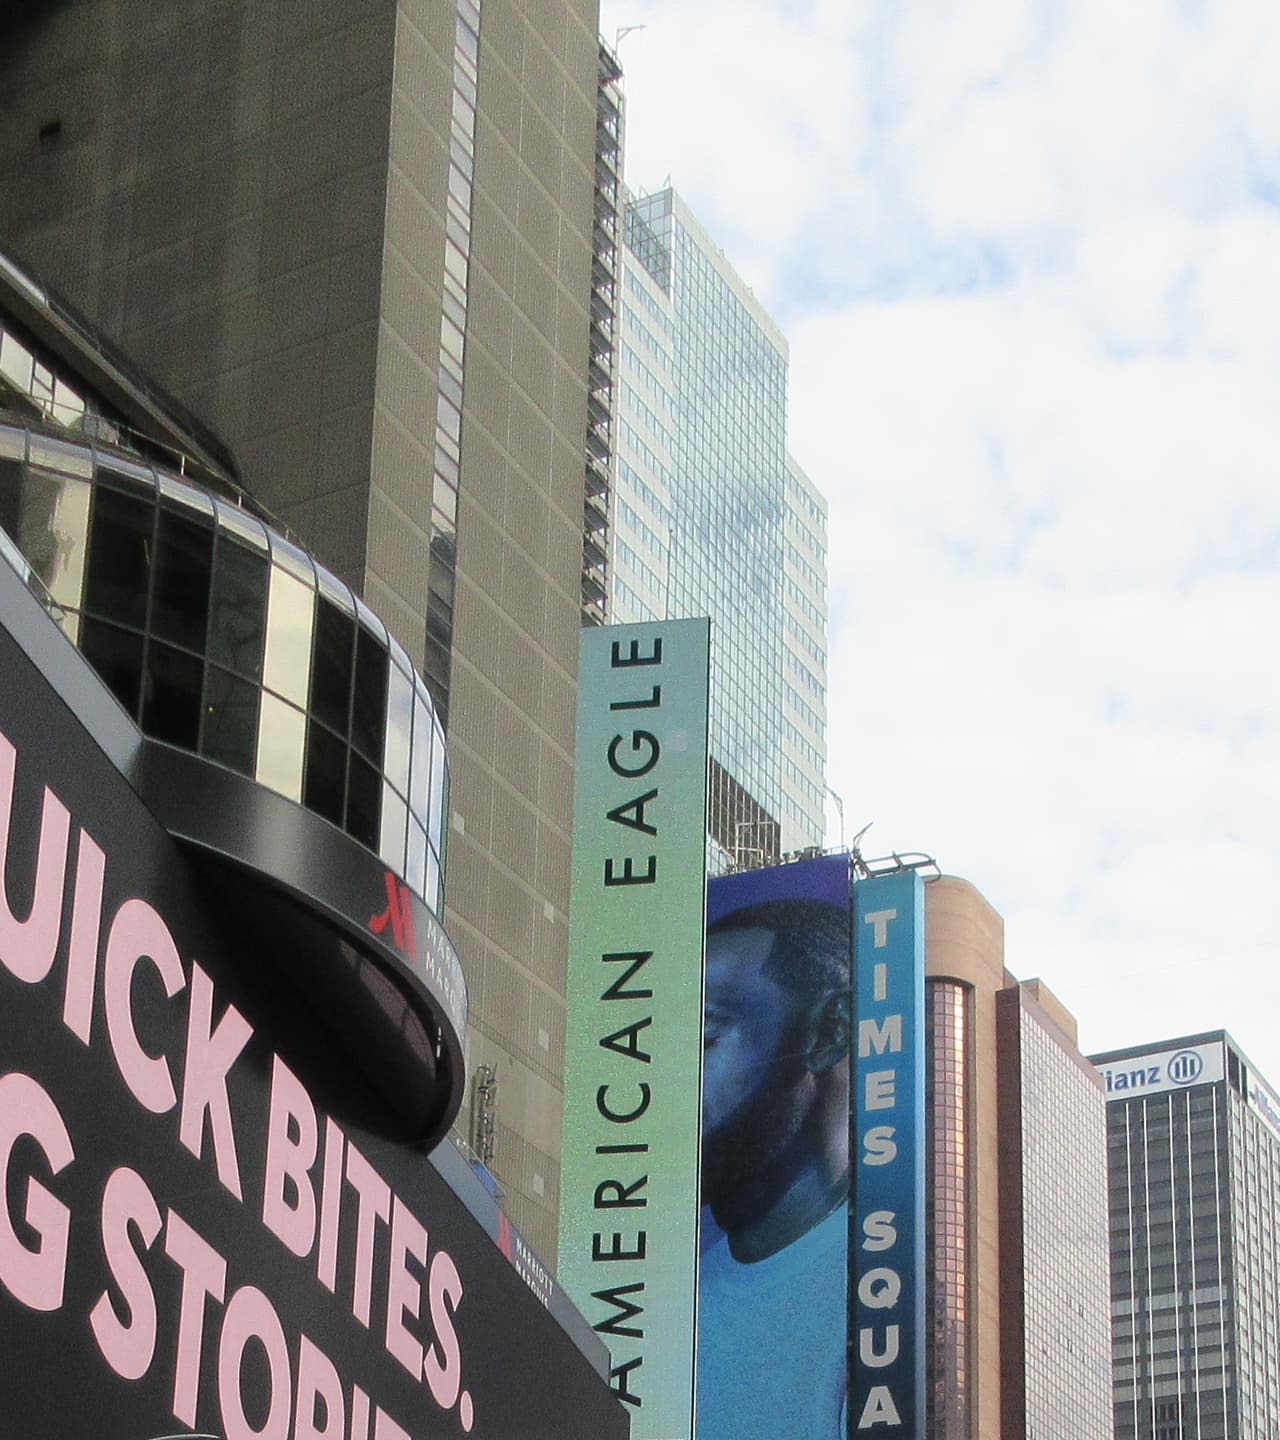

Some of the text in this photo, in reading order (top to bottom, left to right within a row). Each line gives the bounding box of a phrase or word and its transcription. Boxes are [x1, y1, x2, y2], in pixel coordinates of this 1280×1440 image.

[604, 636, 664, 886] EAGLE
[858, 908, 903, 1167] TIMES
[1102, 1064, 1161, 1093] ianz
[261, 1052, 476, 1434] BITES.
[515, 1237, 555, 1296] MARRIOTT
[592, 946, 654, 1408] AMERICAN
